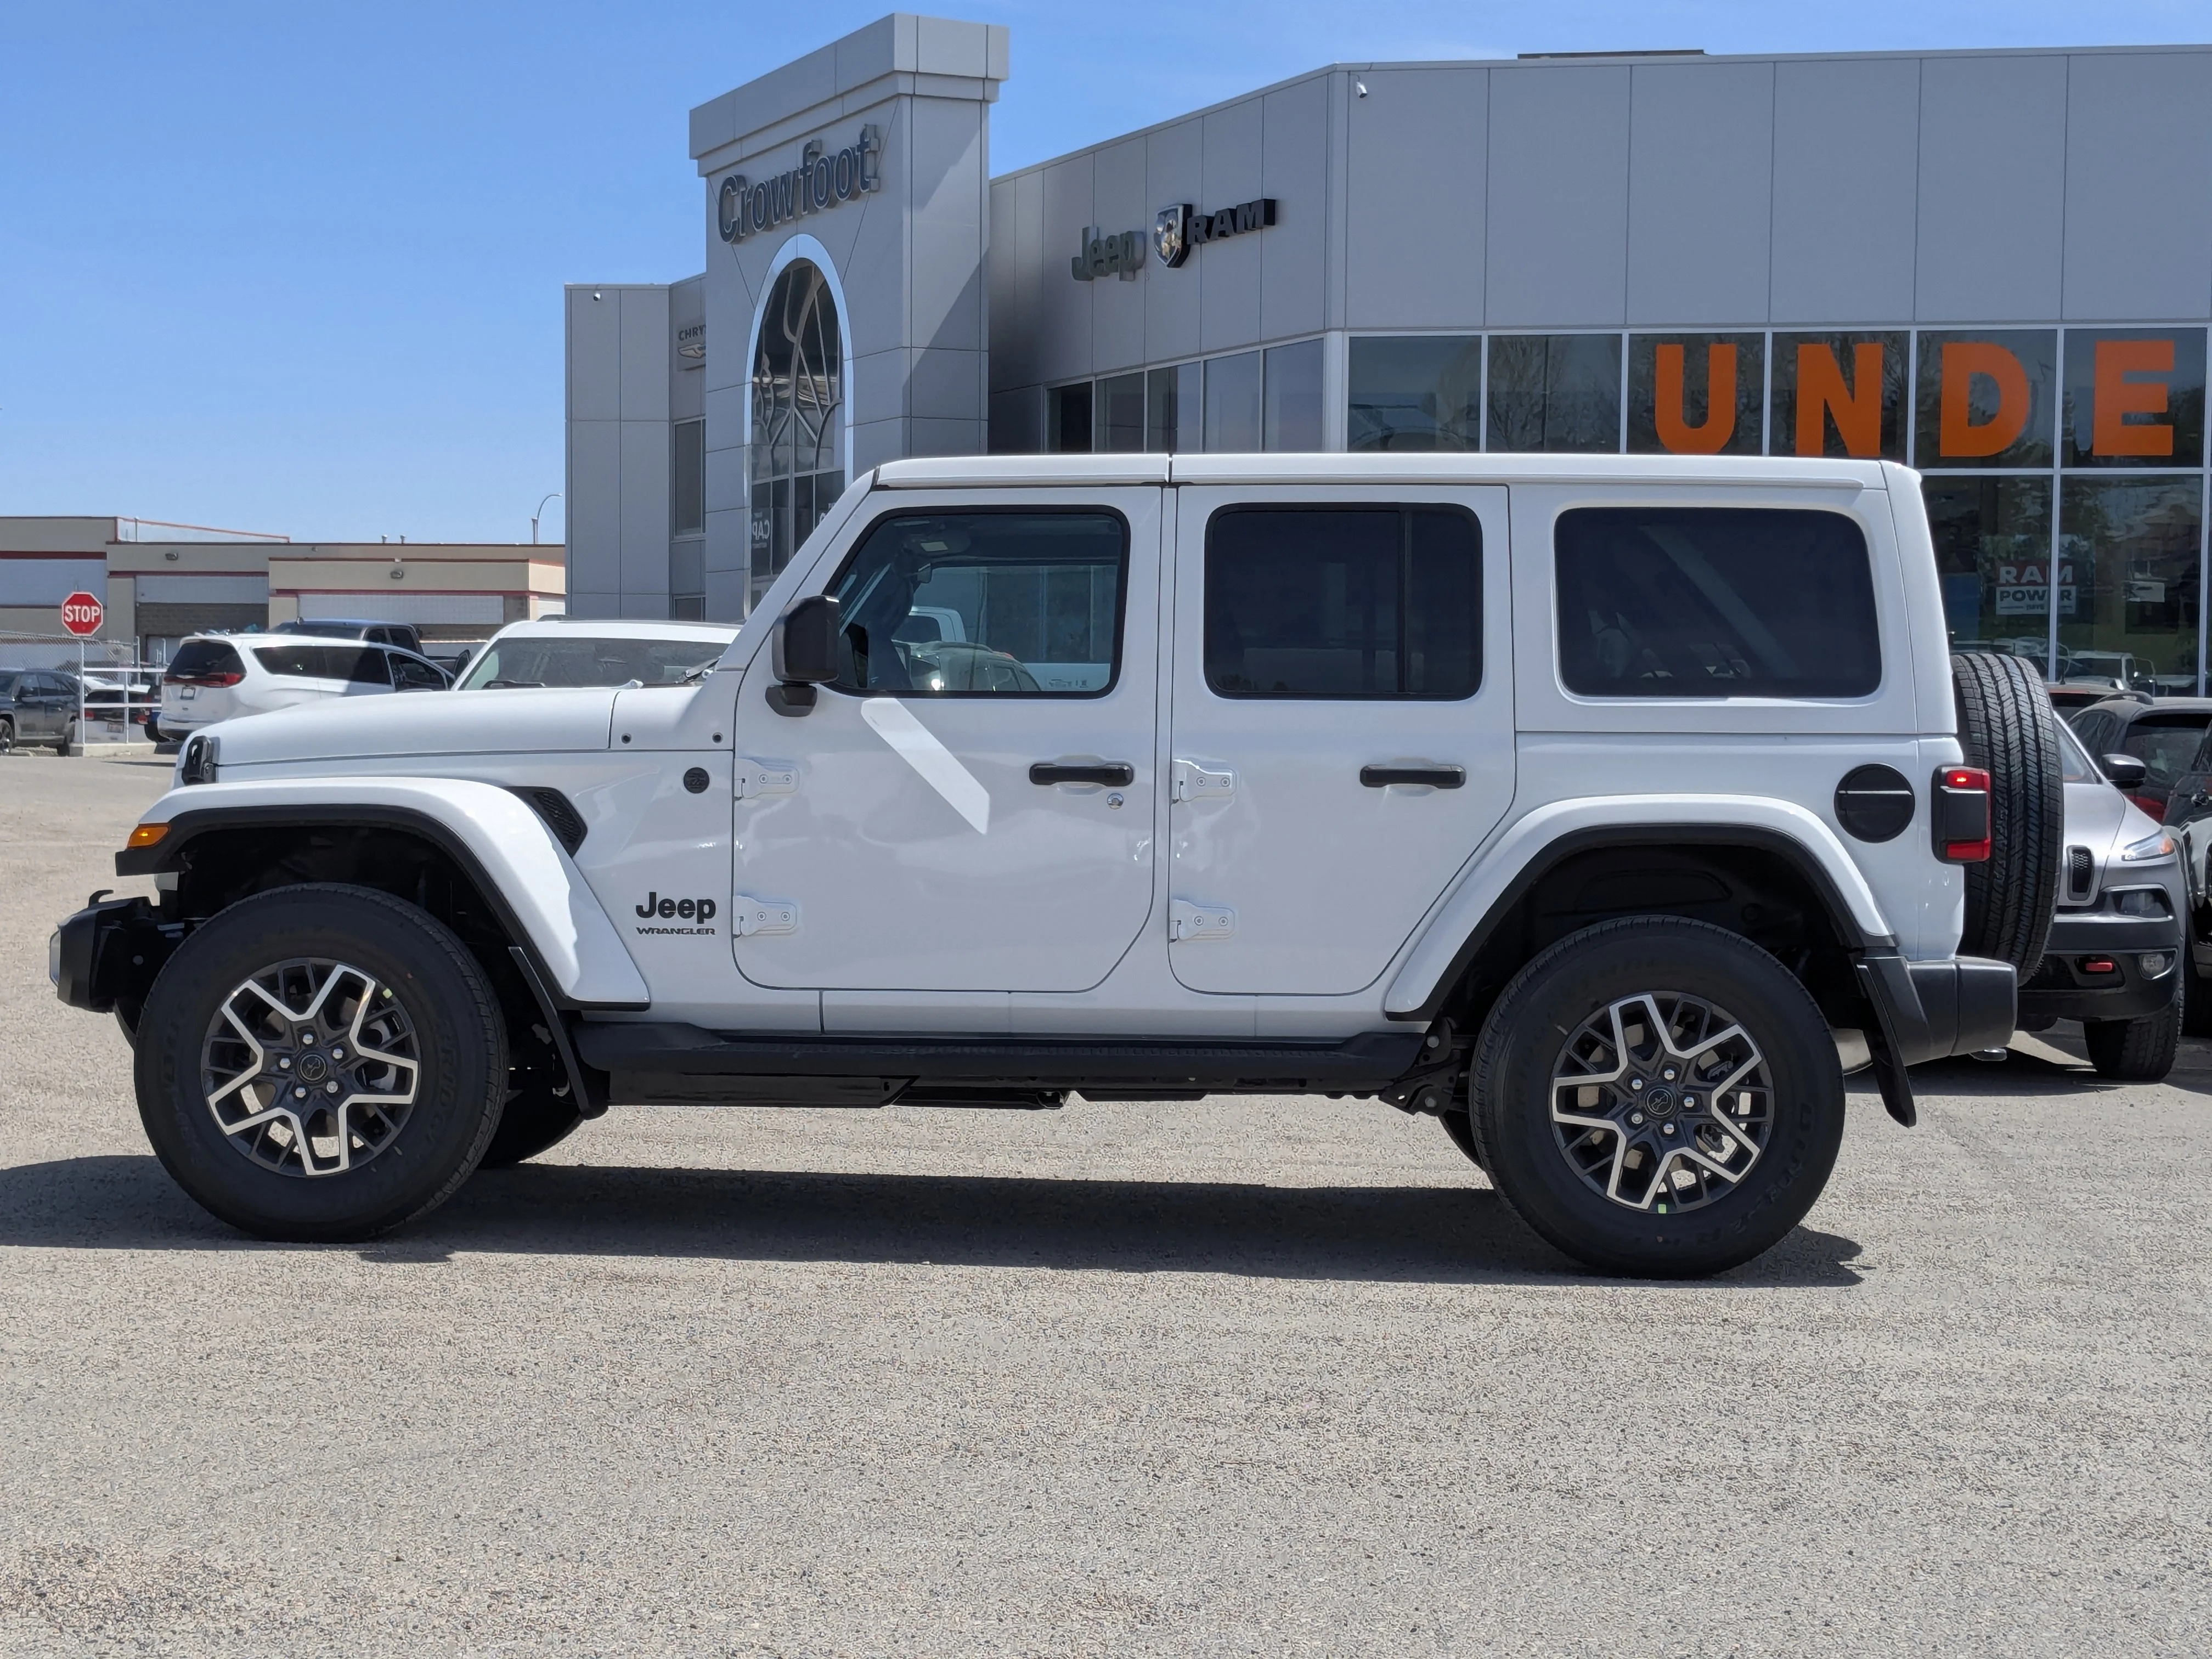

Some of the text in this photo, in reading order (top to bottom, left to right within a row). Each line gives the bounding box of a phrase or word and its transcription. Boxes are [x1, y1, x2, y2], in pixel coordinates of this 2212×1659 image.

[718, 123, 880, 244] Crowfoot
[1187, 198, 1276, 245] RAM
[1071, 226, 1146, 281] Jeep
[1999, 565, 2073, 584] RAM
[1999, 590, 2073, 602] POWR
[64, 605, 100, 623] STOP
[636, 891, 716, 924] Jeep
[636, 927, 716, 935] WRANGLER
